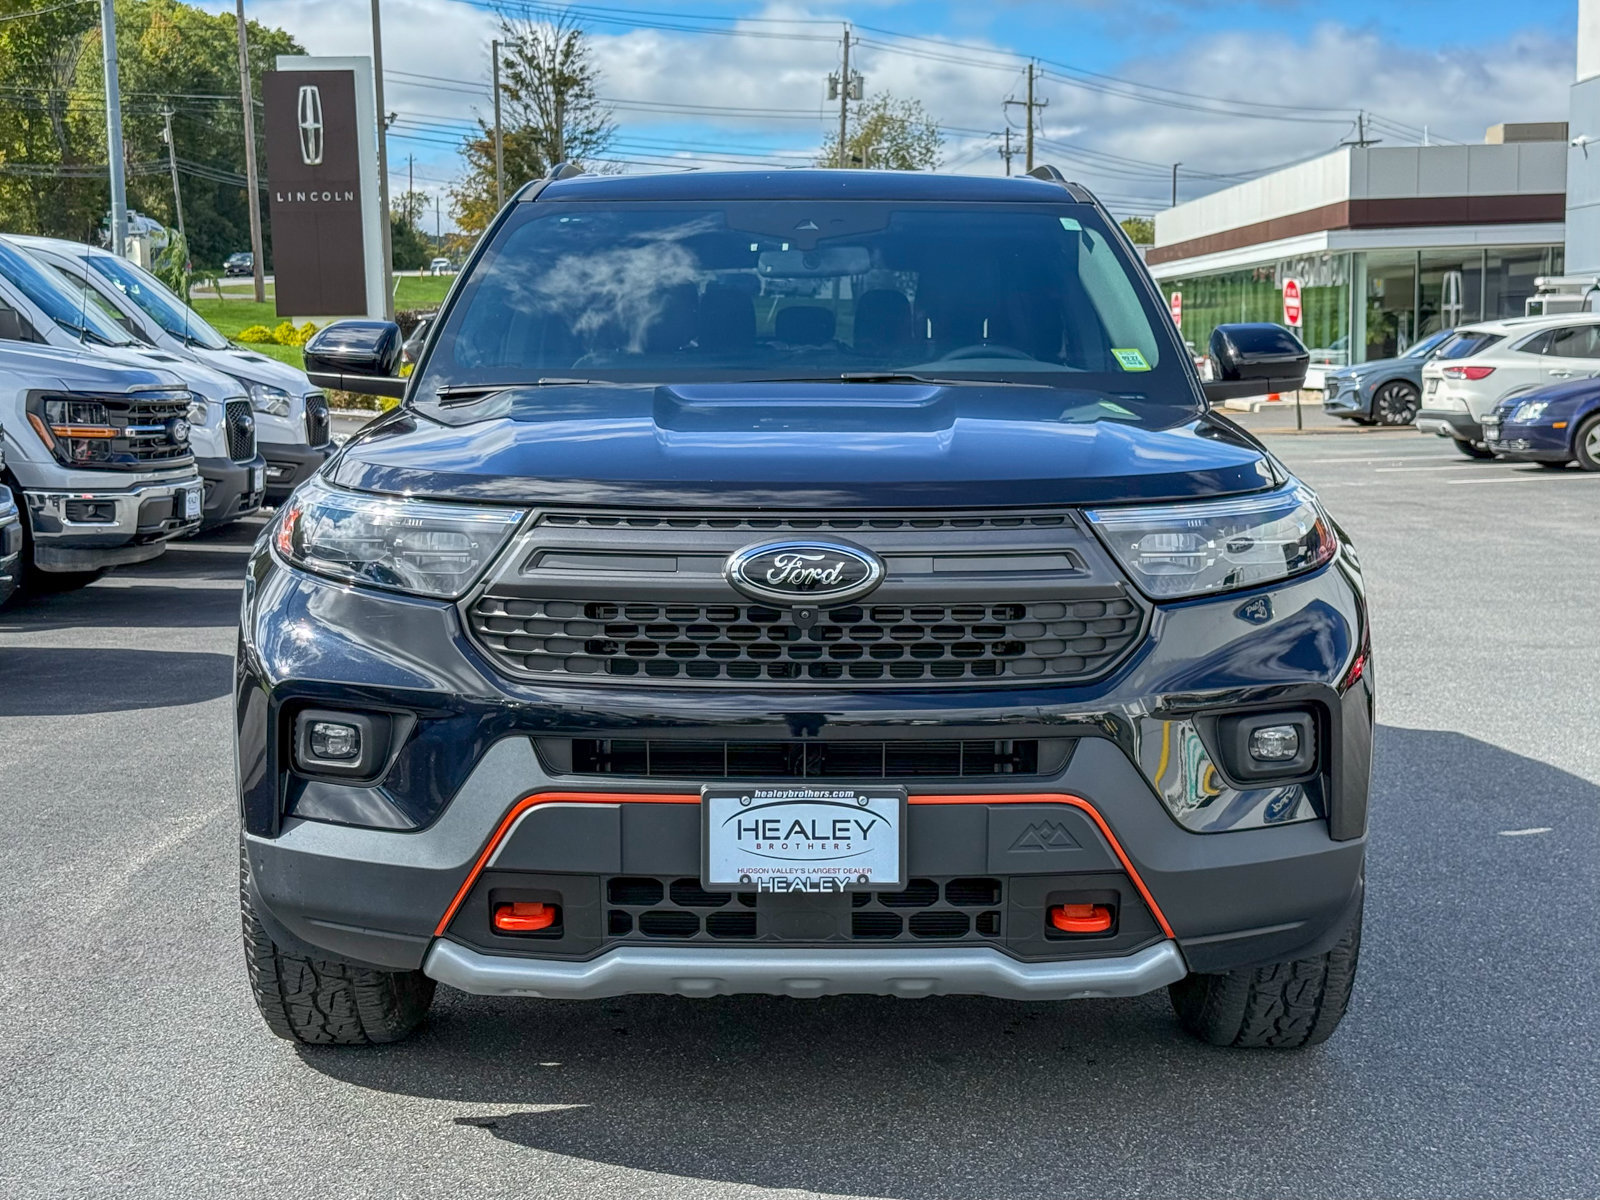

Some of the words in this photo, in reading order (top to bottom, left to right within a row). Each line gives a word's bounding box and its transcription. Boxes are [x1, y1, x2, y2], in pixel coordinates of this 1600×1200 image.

[276, 191, 354, 202] LINCOLN
[766, 553, 845, 585] Ford
[754, 789, 855, 799] healeybrothers.com
[737, 819, 877, 841] HEALEY
[843, 867, 873, 875] DEALER
[757, 877, 850, 893] HEALEY
